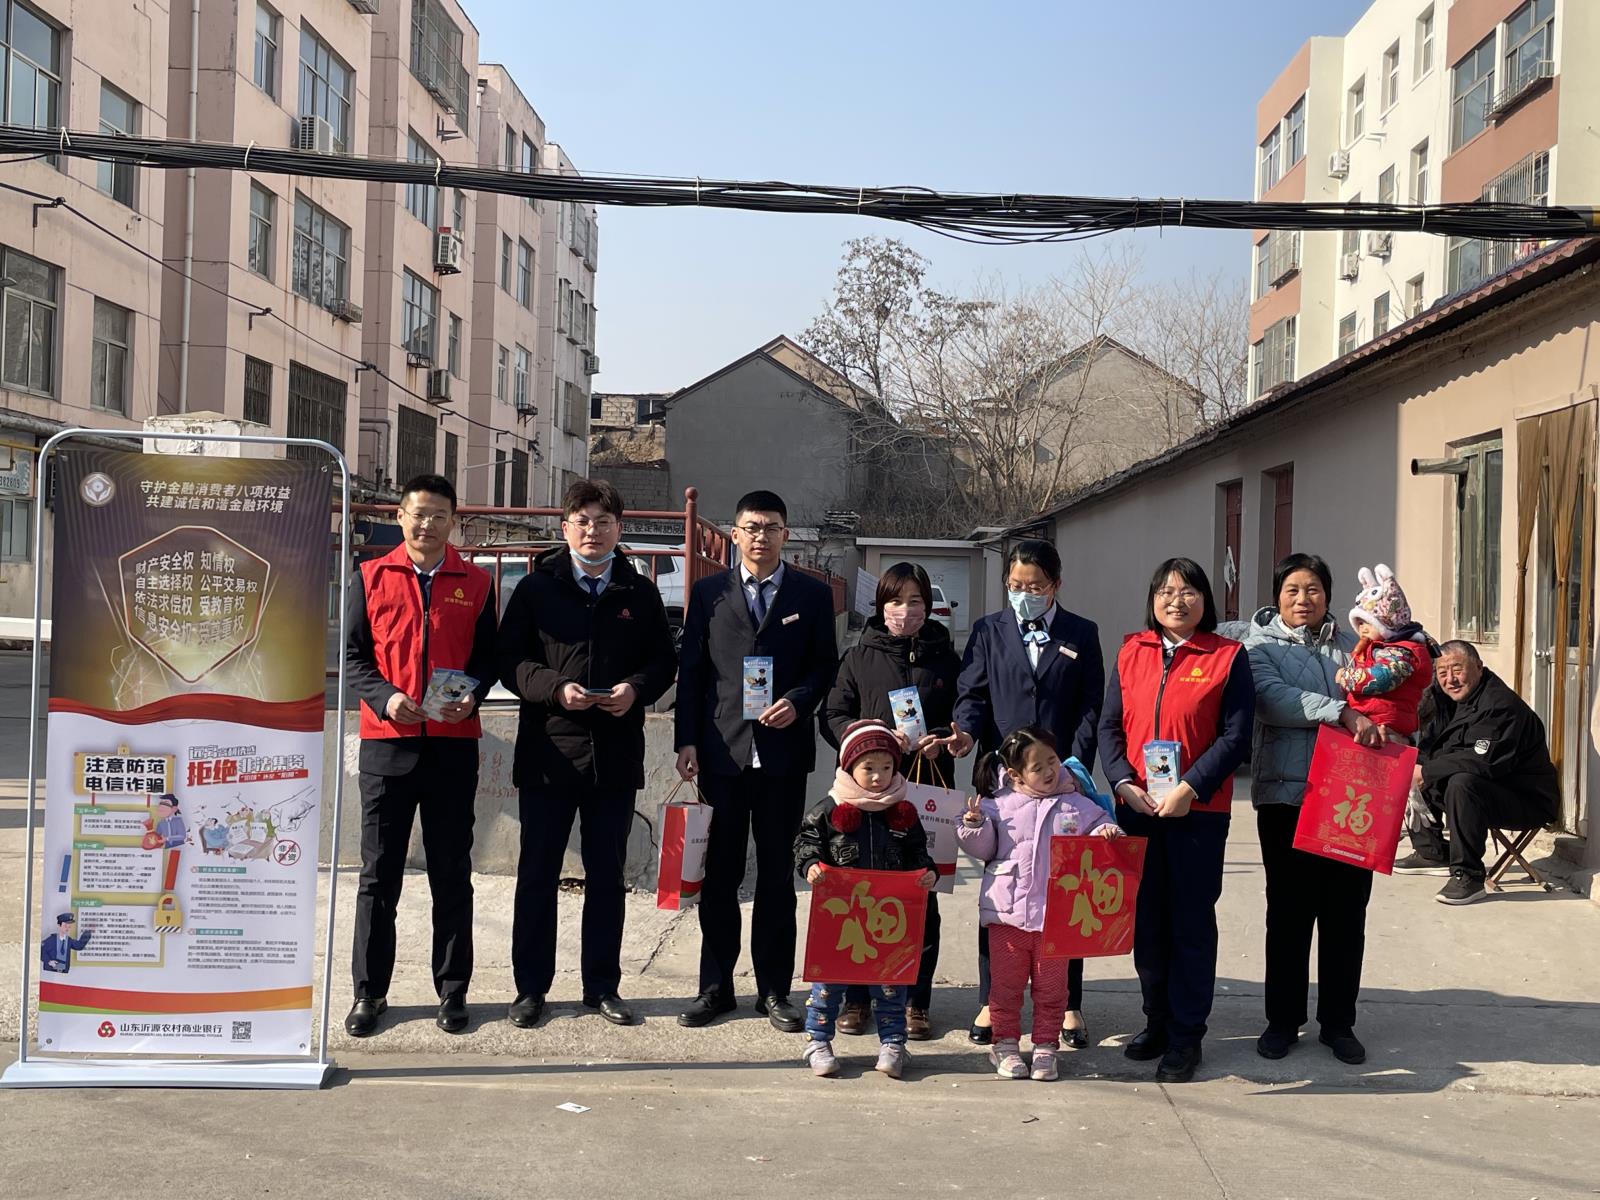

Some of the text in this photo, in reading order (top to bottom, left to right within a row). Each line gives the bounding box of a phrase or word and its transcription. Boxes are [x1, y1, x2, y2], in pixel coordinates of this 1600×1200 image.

[140, 480, 291, 500] 守护金融消费者八项权益
[146, 495, 284, 513] 共建诚信和谐金融环境
[135, 550, 235, 574] 财产安全权 知情权
[135, 574, 258, 594] 自主选择权 公平交易权
[134, 590, 246, 616] 依法求偿权 受教育权
[134, 604, 244, 646] 信息安全权 受尊重权
[86, 757, 166, 774] 注意防范
[187, 755, 305, 787] 拒绝非法集资
[86, 776, 165, 793] 电信诈骗
[1332, 785, 1373, 835] 福
[1056, 848, 1124, 937] 福
[822, 880, 907, 964] 福
[120, 1023, 224, 1034] 山东沂源农村商业银行
